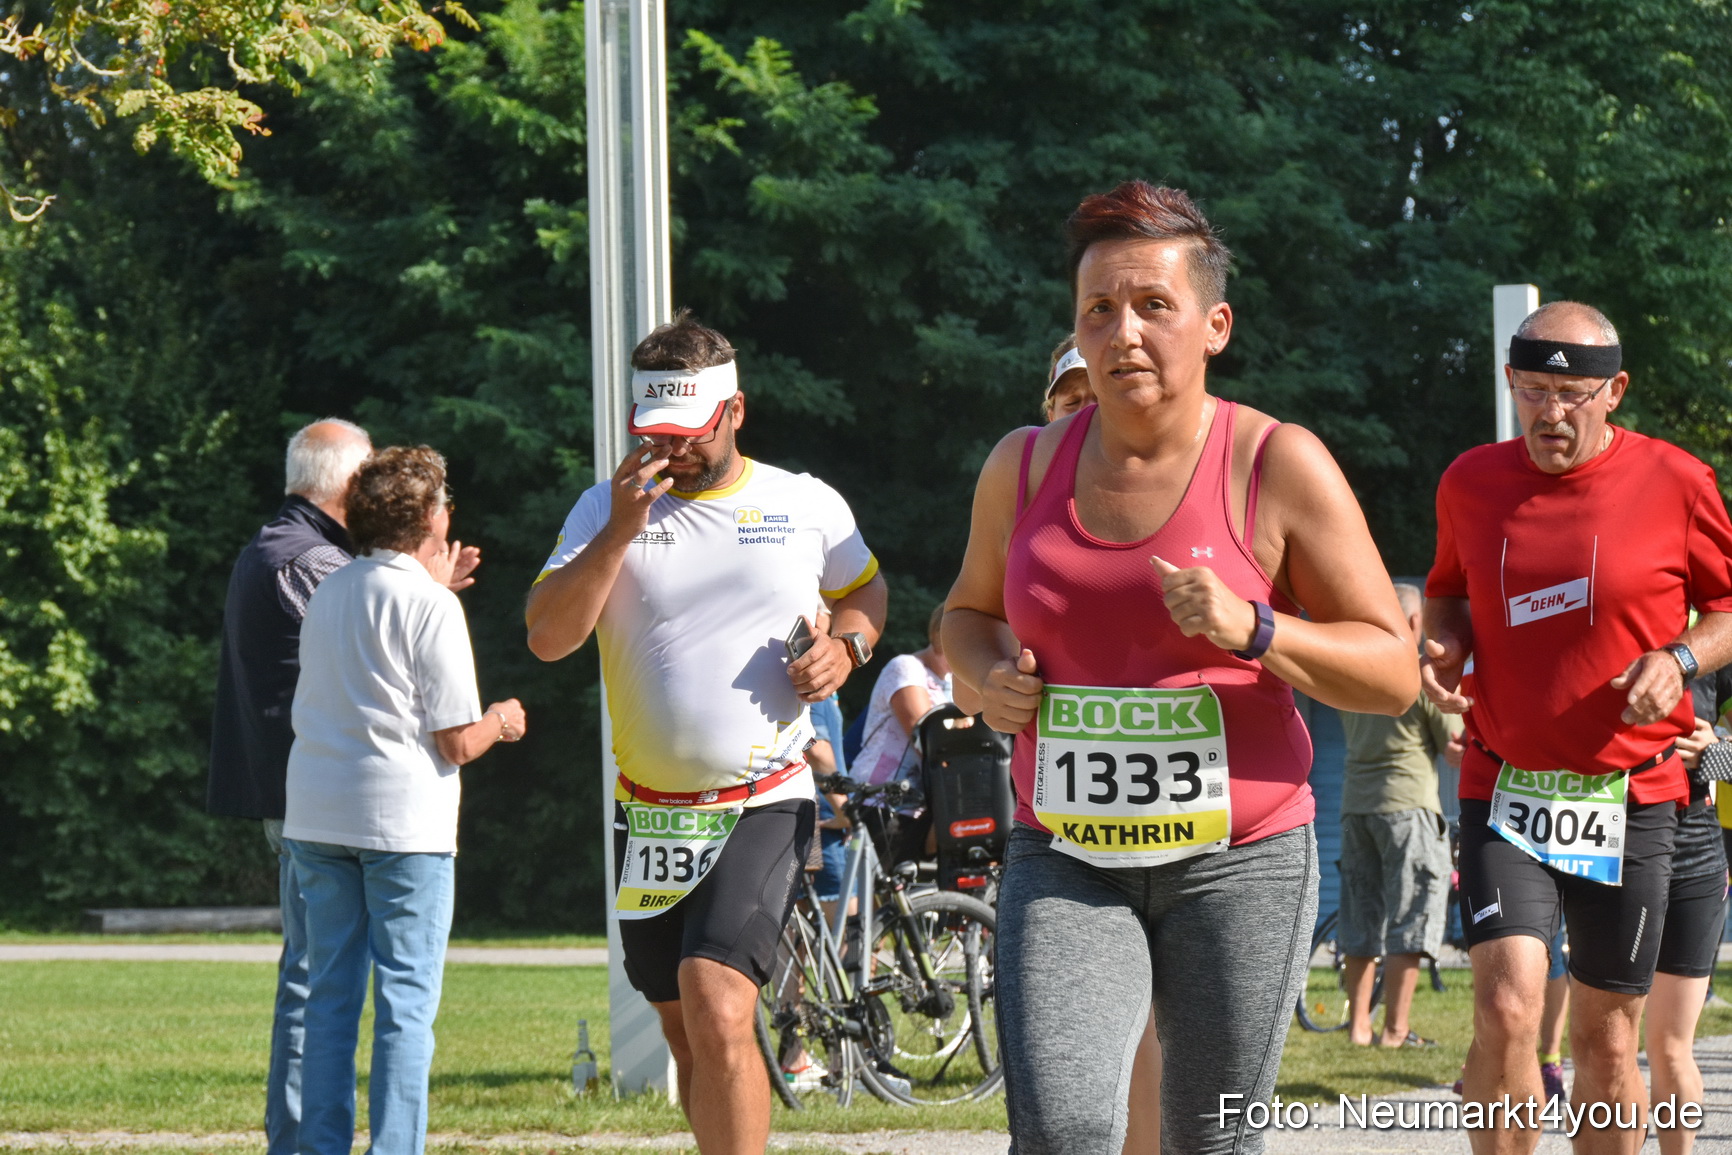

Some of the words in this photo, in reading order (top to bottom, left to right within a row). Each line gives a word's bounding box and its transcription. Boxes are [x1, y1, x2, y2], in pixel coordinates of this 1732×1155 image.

[1546, 359, 1569, 368] adidas
[737, 509, 762, 524] 20
[634, 531, 676, 542] OCK
[737, 525, 796, 534] Neumarkter
[738, 535, 786, 546] Stadtlauf
[1530, 592, 1565, 613] DEHN
[1050, 697, 1203, 734] BOCK
[1208, 752, 1217, 762] D
[1055, 751, 1202, 805] 1333
[1510, 768, 1606, 797] BOCK
[634, 808, 726, 835] BOCK
[1505, 801, 1607, 848] 3004
[1611, 814, 1619, 822] C
[1062, 821, 1194, 845] KATHRIN
[639, 846, 718, 883] 1336
[639, 894, 682, 908] BIRG
